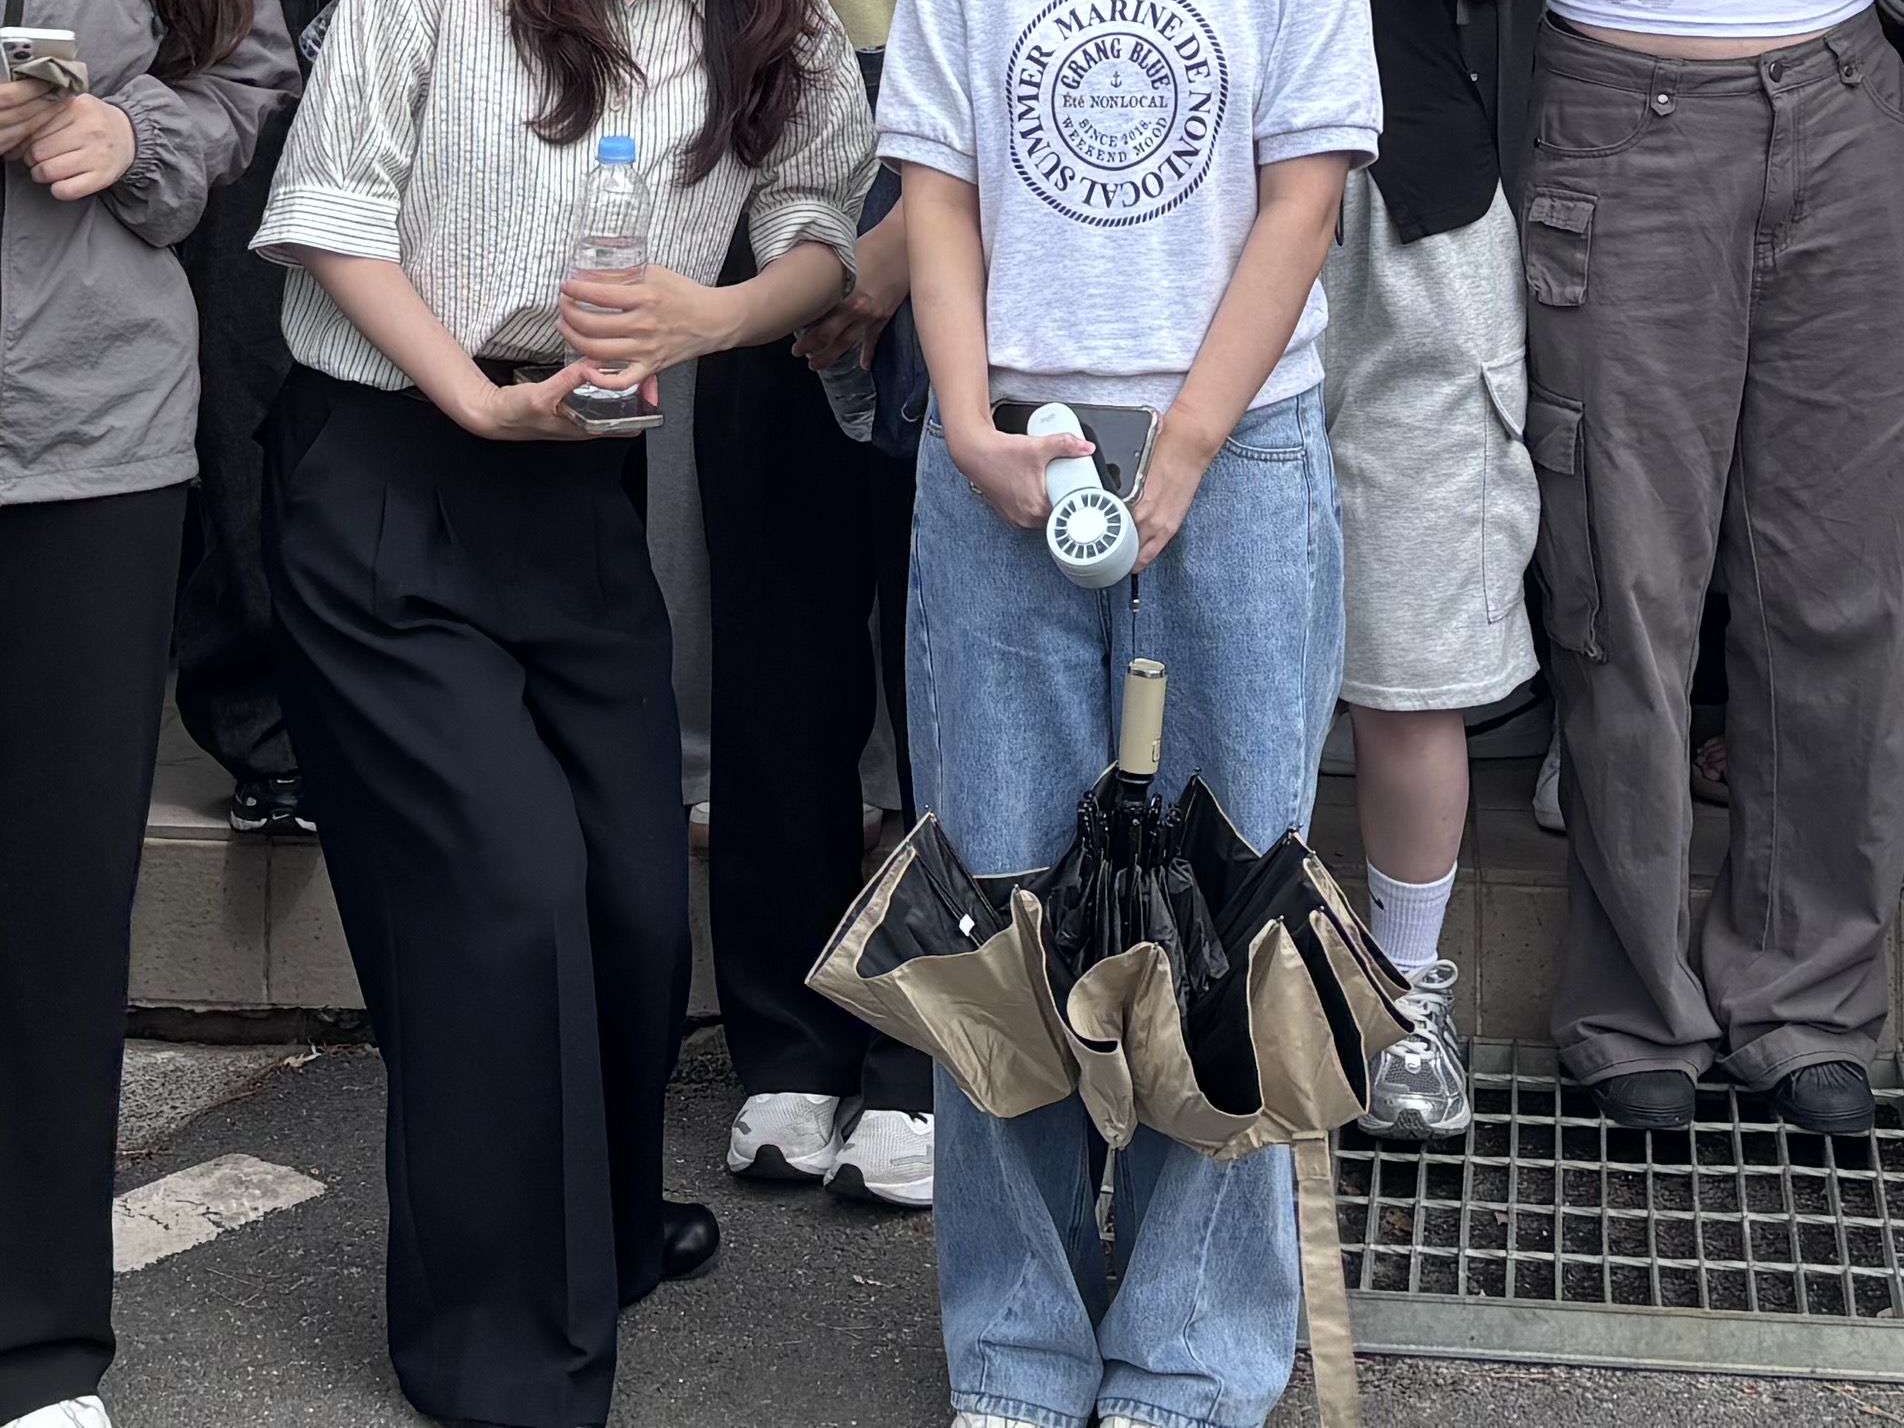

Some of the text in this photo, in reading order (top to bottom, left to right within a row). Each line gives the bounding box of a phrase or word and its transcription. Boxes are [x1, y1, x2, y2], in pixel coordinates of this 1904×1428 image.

[1128, 40, 1171, 90] BLUE
[1174, 32, 1212, 84] DE
[1017, 44, 1076, 192] SUMMER
[1090, 95, 1168, 108] NONLOCAL
[1062, 115, 1168, 163] WEEKEND MOOD
[1079, 118, 1118, 148] SINCE
[1079, 90, 1213, 208] NONLOCAL
